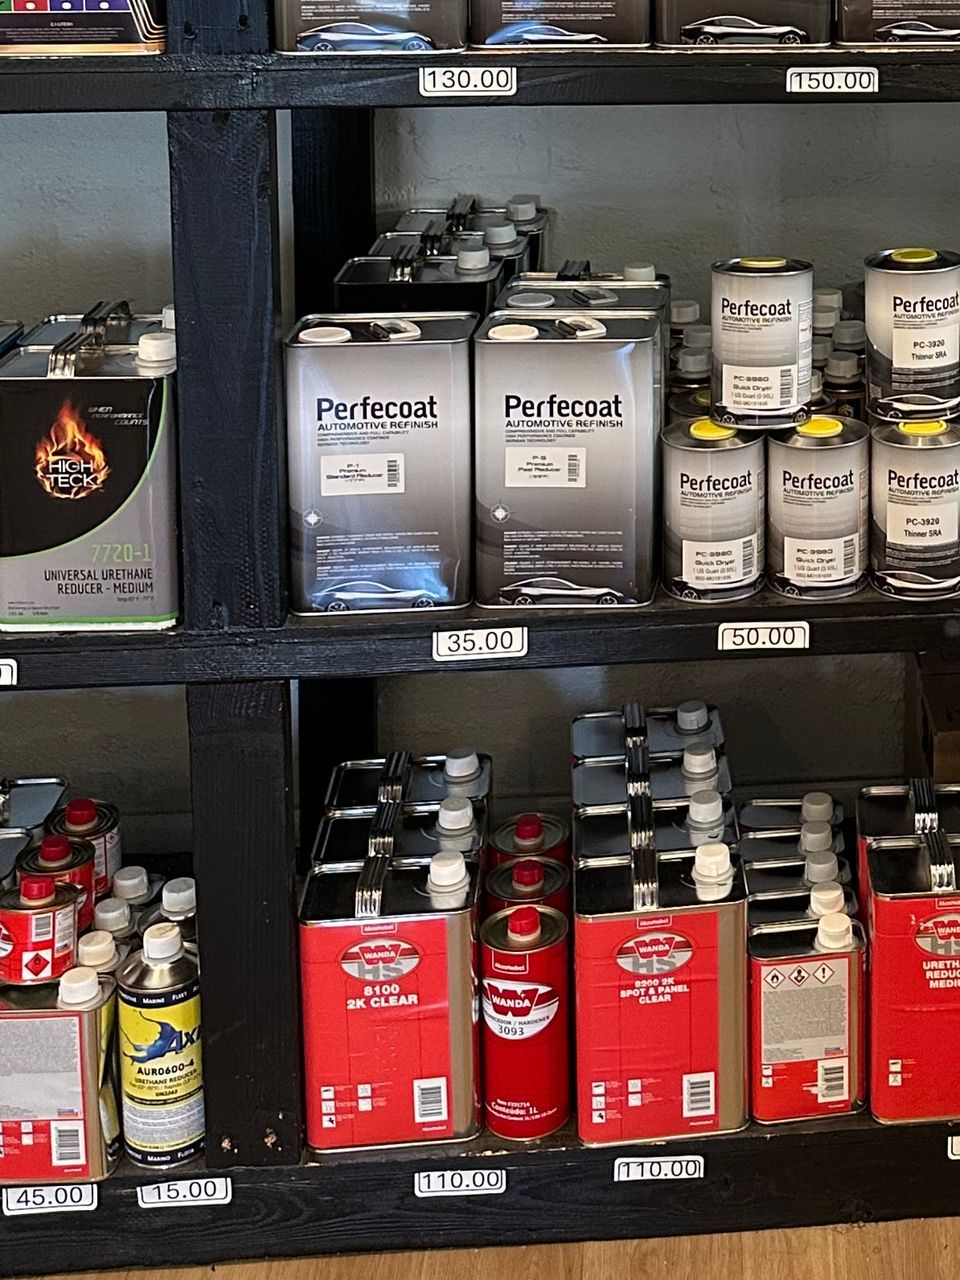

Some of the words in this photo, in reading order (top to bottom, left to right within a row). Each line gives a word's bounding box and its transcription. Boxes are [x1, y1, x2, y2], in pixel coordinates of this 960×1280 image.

[427, 69, 509, 90] 130.00
[794, 71, 871, 90] 150.00
[318, 422, 388, 431] AUTOMOTIVE
[390, 421, 438, 429] REFINISH
[506, 420, 573, 428] AUTOMOTIVE
[48, 458, 93, 474] HIGH
[49, 473, 99, 488] TECK
[906, 517, 940, 526] PC-3920
[904, 529, 928, 538] Thinner
[929, 529, 942, 538] SRA
[92, 544, 151, 563] 7720-1
[45, 569, 98, 581] UNIVERSAL
[101, 567, 152, 581] URETHANE
[58, 582, 102, 595] REDUCER
[114, 581, 154, 595] MEDIUM
[448, 631, 514, 653] 35.00
[732, 627, 796, 646] 50.00
[364, 951, 396, 960] WANDA
[639, 944, 669, 953] WANDA
[363, 984, 400, 995] 8100
[635, 979, 659, 988] 8200
[662, 977, 675, 985] 2K
[172, 991, 187, 1001] FLEET
[620, 989, 646, 998] SPOT
[658, 985, 689, 993] PANEL
[347, 999, 366, 1009] 2K
[370, 994, 418, 1007] CLEAR
[639, 994, 671, 1004] CLEAR
[498, 1025, 524, 1036] 3093
[137, 1059, 195, 1076] AUR0600-4
[622, 1160, 698, 1179] 110.00
[422, 1171, 500, 1191] 110.00
[16, 1186, 84, 1207] 45.00
[152, 1180, 218, 1201] 15.00
